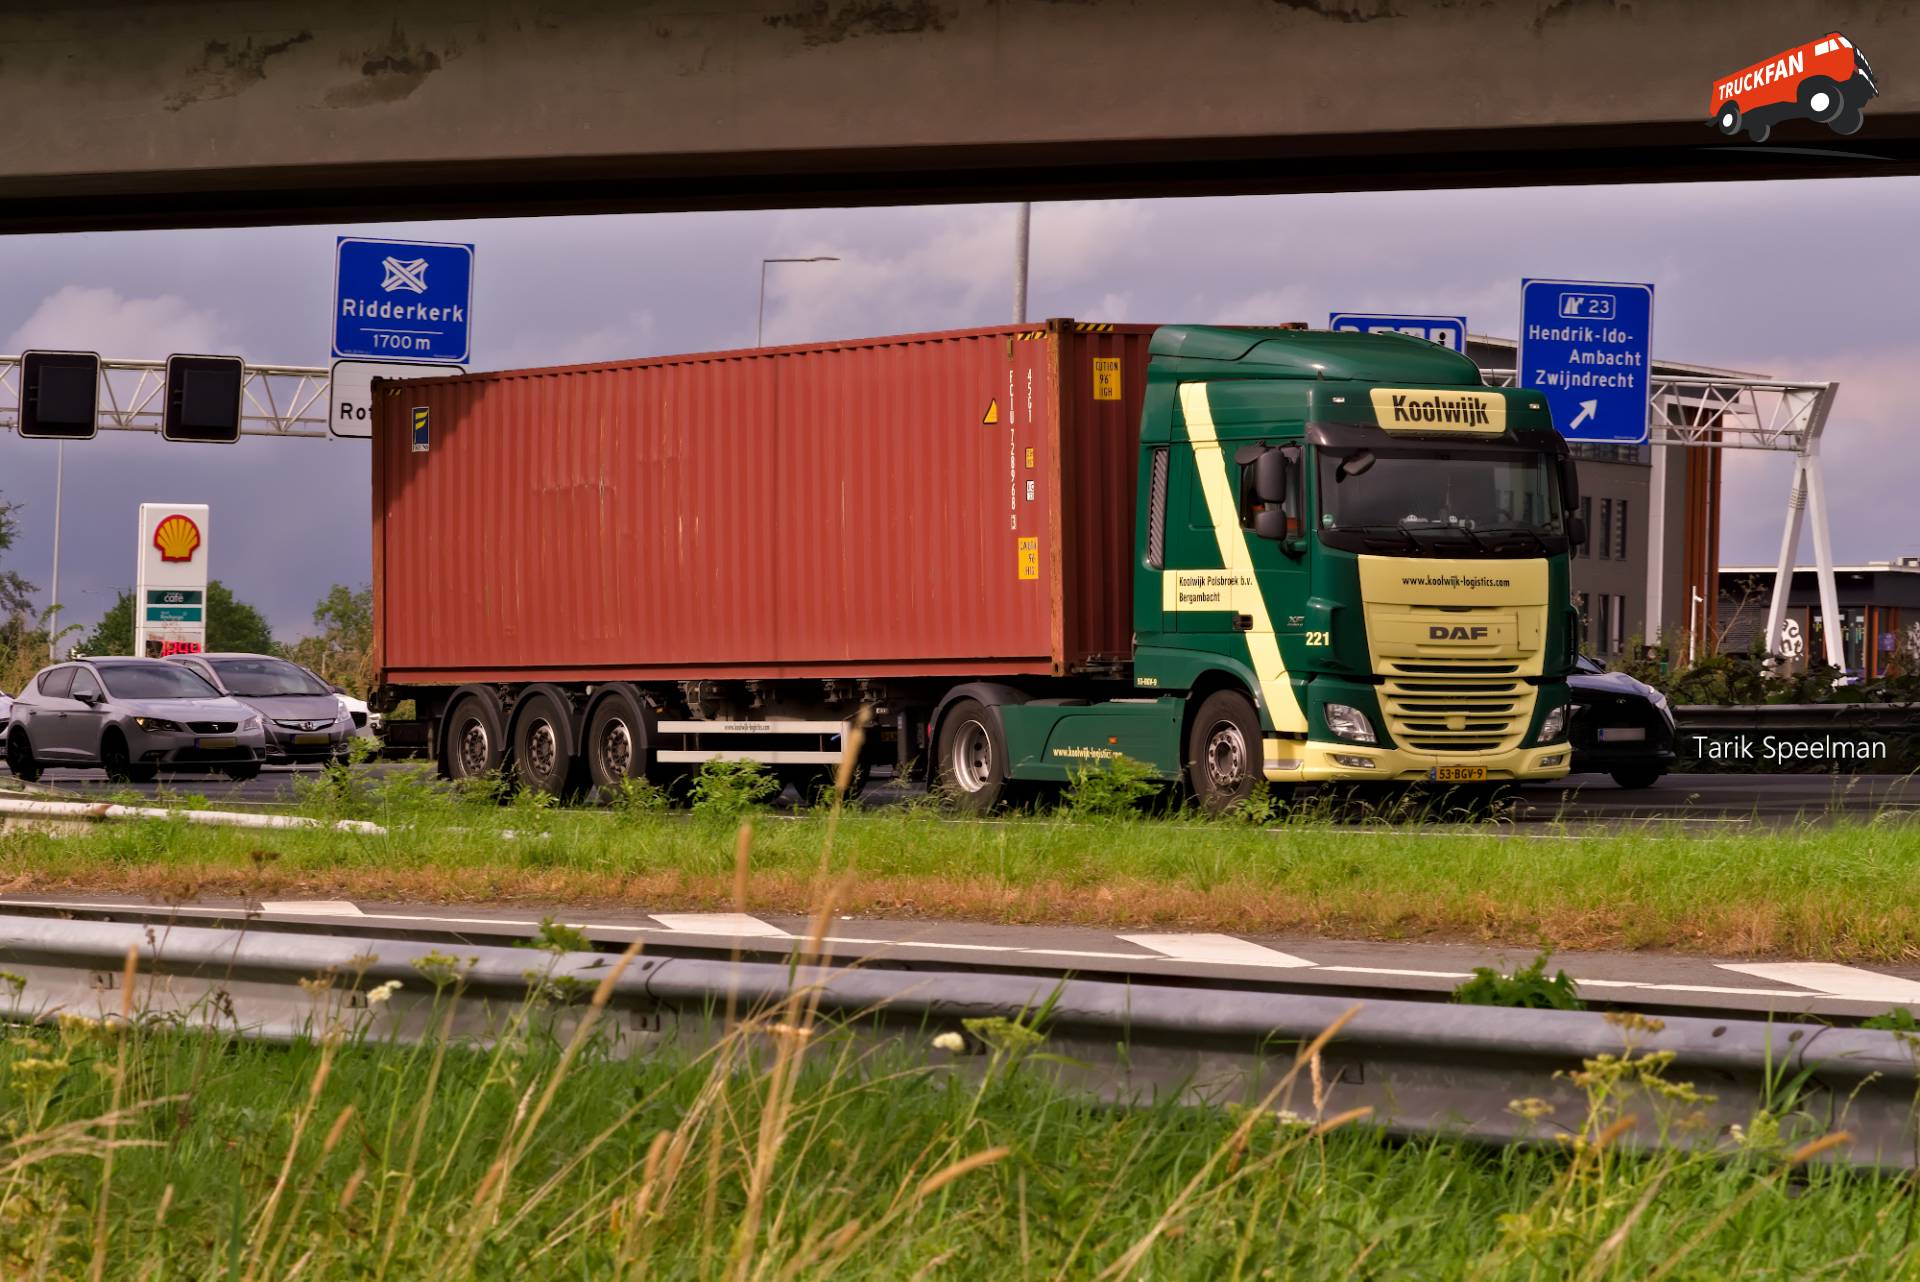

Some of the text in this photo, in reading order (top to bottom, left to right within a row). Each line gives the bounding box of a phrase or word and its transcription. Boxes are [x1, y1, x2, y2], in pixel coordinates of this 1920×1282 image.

[342, 298, 464, 322] Ridderkerk
[1588, 299, 1610, 314] 23
[1529, 324, 1634, 343] Hendrik-Ido-
[373, 334, 431, 351] 1700 m
[1568, 348, 1642, 366] Ambacht
[1535, 369, 1635, 391] Zwijndrecht
[1392, 394, 1490, 428] Koolwijk
[1179, 576, 1206, 588] Koolwijk
[1207, 576, 1239, 587] Polsbroek
[1401, 574, 1511, 590] www.koolwijk-logistics.com
[1179, 592, 1221, 605] Bergambacht
[1305, 631, 1330, 646] 221
[1429, 626, 1489, 641] DAF
[1439, 768, 1484, 780] 53-BGV-9
